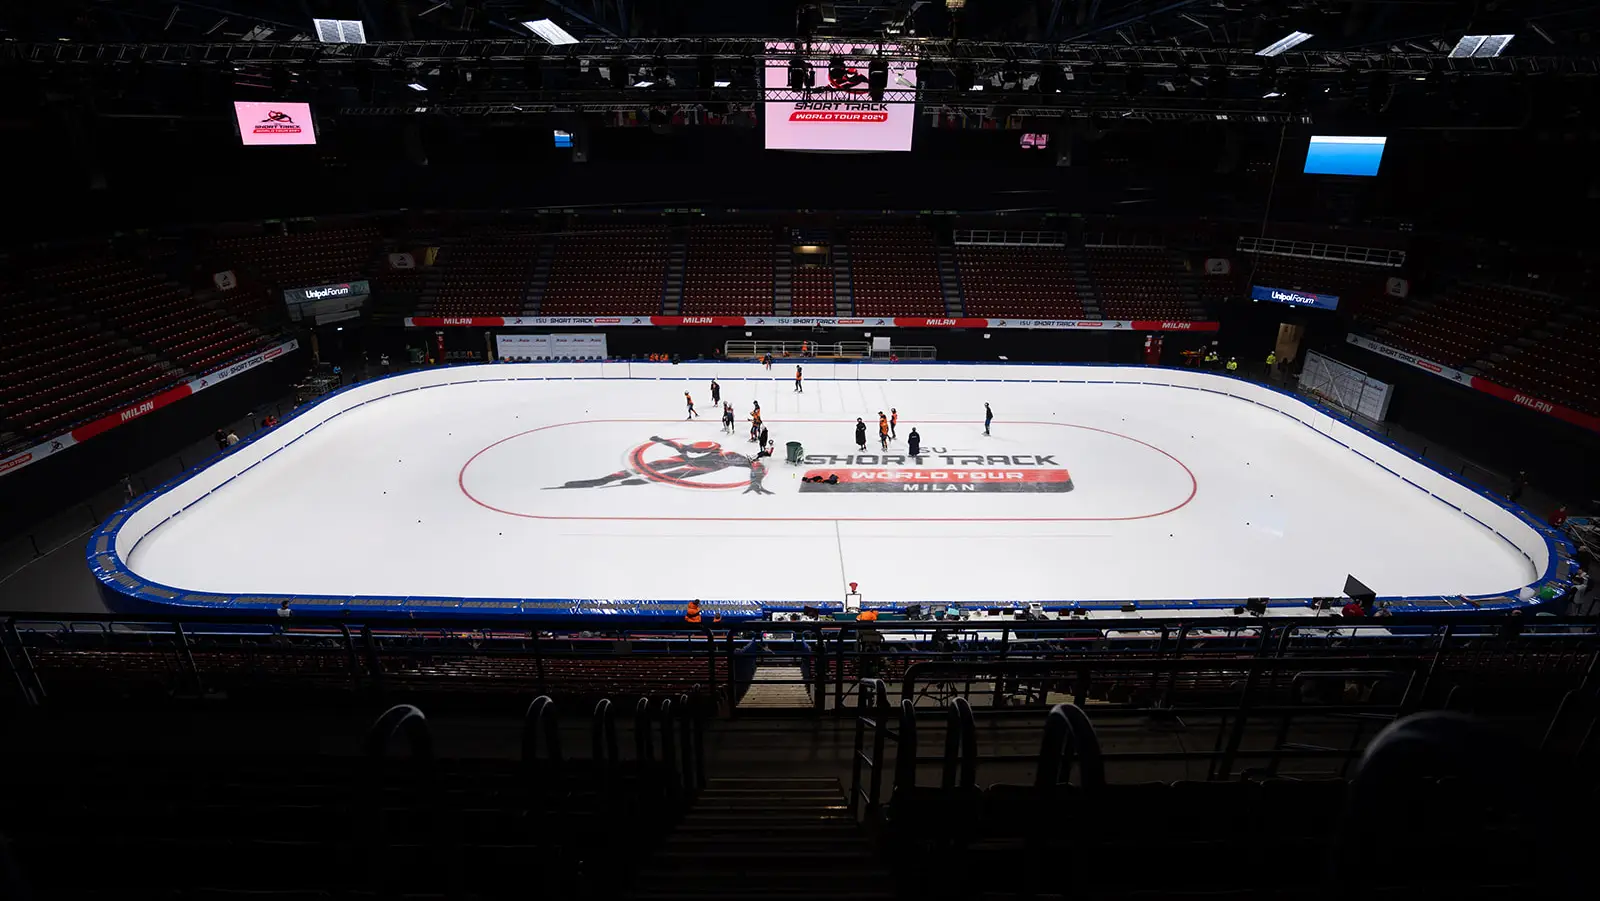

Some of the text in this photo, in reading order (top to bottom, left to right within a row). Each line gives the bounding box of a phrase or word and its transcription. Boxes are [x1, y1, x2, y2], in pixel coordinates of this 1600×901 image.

[794, 102, 889, 111] SHORT TRACK
[305, 287, 349, 299] UnipolForum
[1271, 290, 1315, 304] UnipolForum
[443, 317, 473, 325] MILAN
[682, 316, 713, 324] MILAN
[925, 318, 957, 326] MILAN
[1161, 321, 1192, 329] MILAN
[1380, 346, 1398, 358] SHORT
[230, 362, 248, 375] SHORT
[1513, 393, 1553, 413] MILAN
[121, 400, 154, 421] MILAN
[918, 446, 947, 454] SU
[803, 454, 1060, 466] SHORT TRACK
[851, 471, 1024, 480] WORLD TOUR
[903, 483, 975, 492] MILAN
